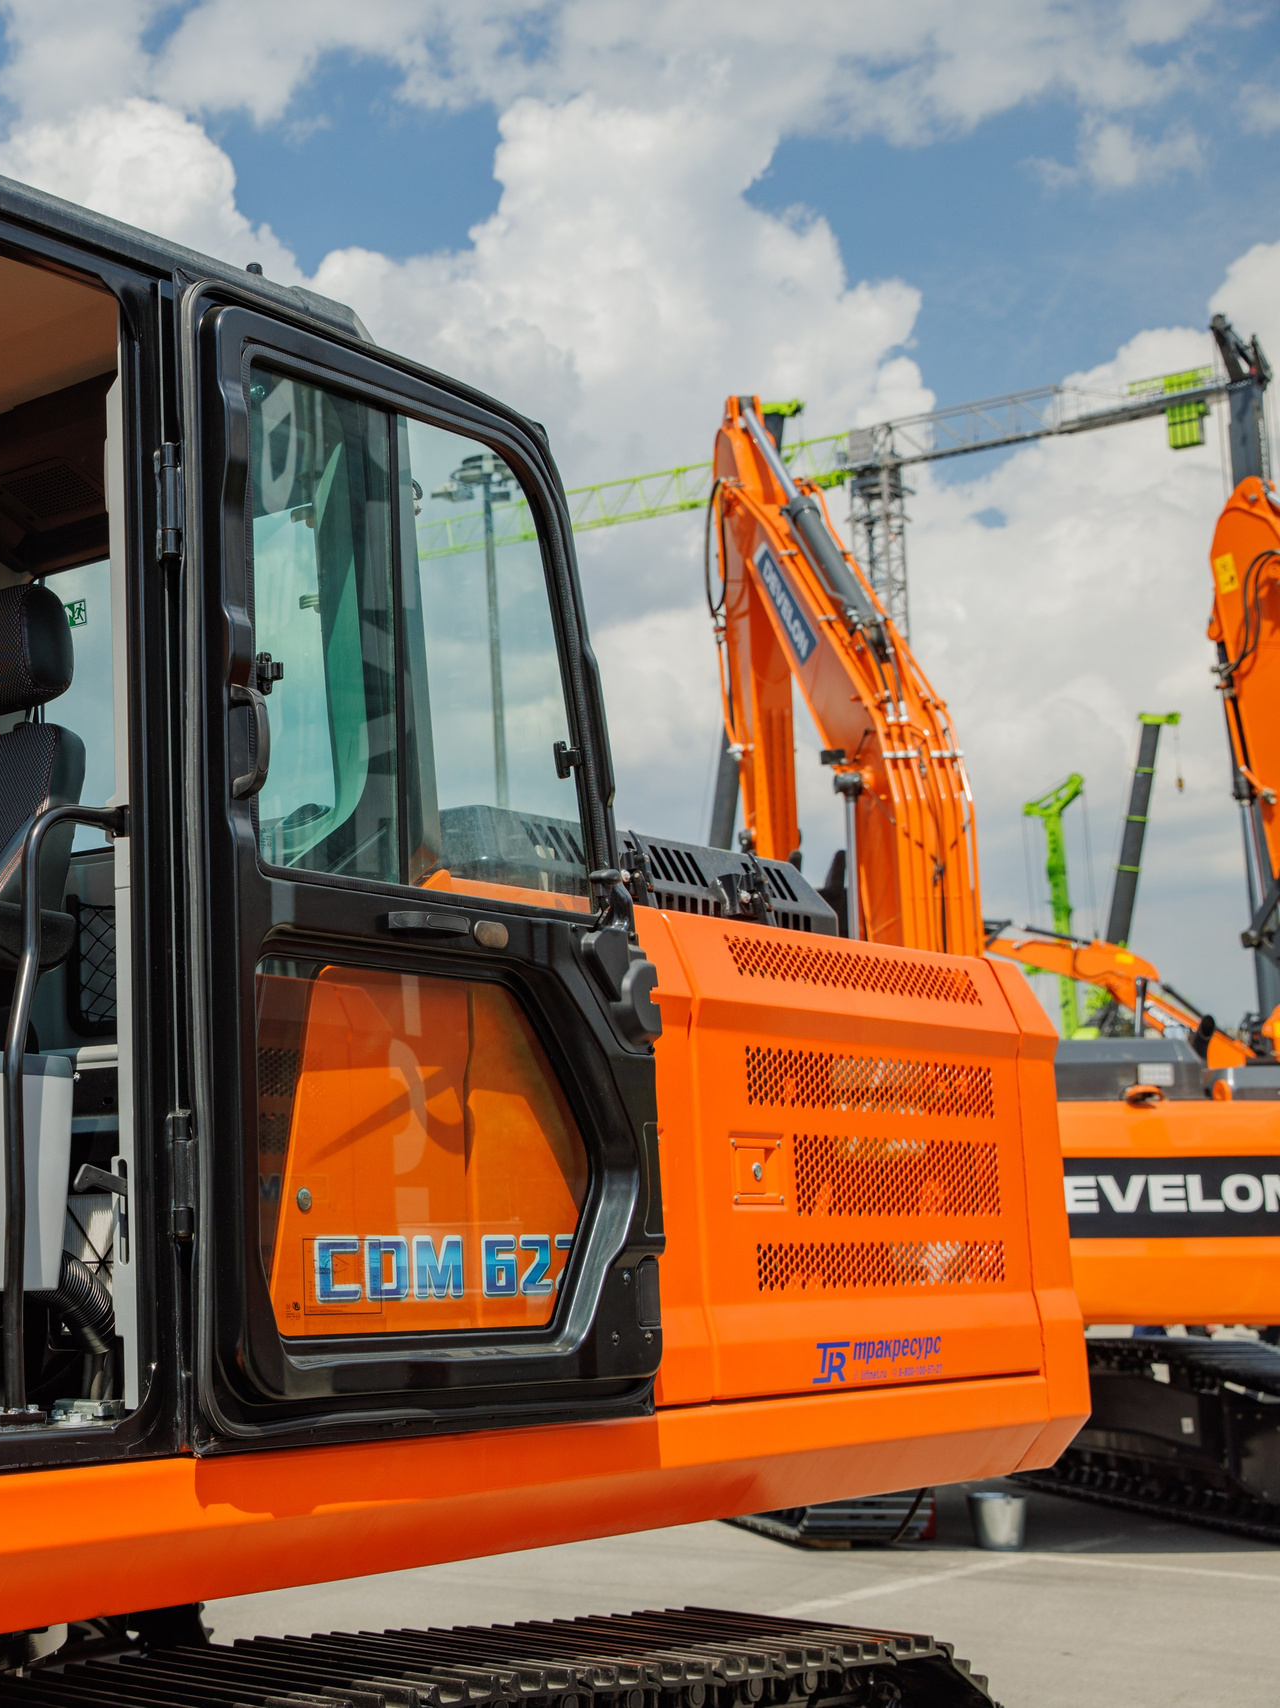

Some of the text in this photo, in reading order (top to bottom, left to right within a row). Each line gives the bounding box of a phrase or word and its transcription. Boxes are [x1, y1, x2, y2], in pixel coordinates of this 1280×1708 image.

[762, 558, 809, 659] DEVELON
[313, 1235, 464, 1304] CDM
[852, 1335, 942, 1364] тракресурс
